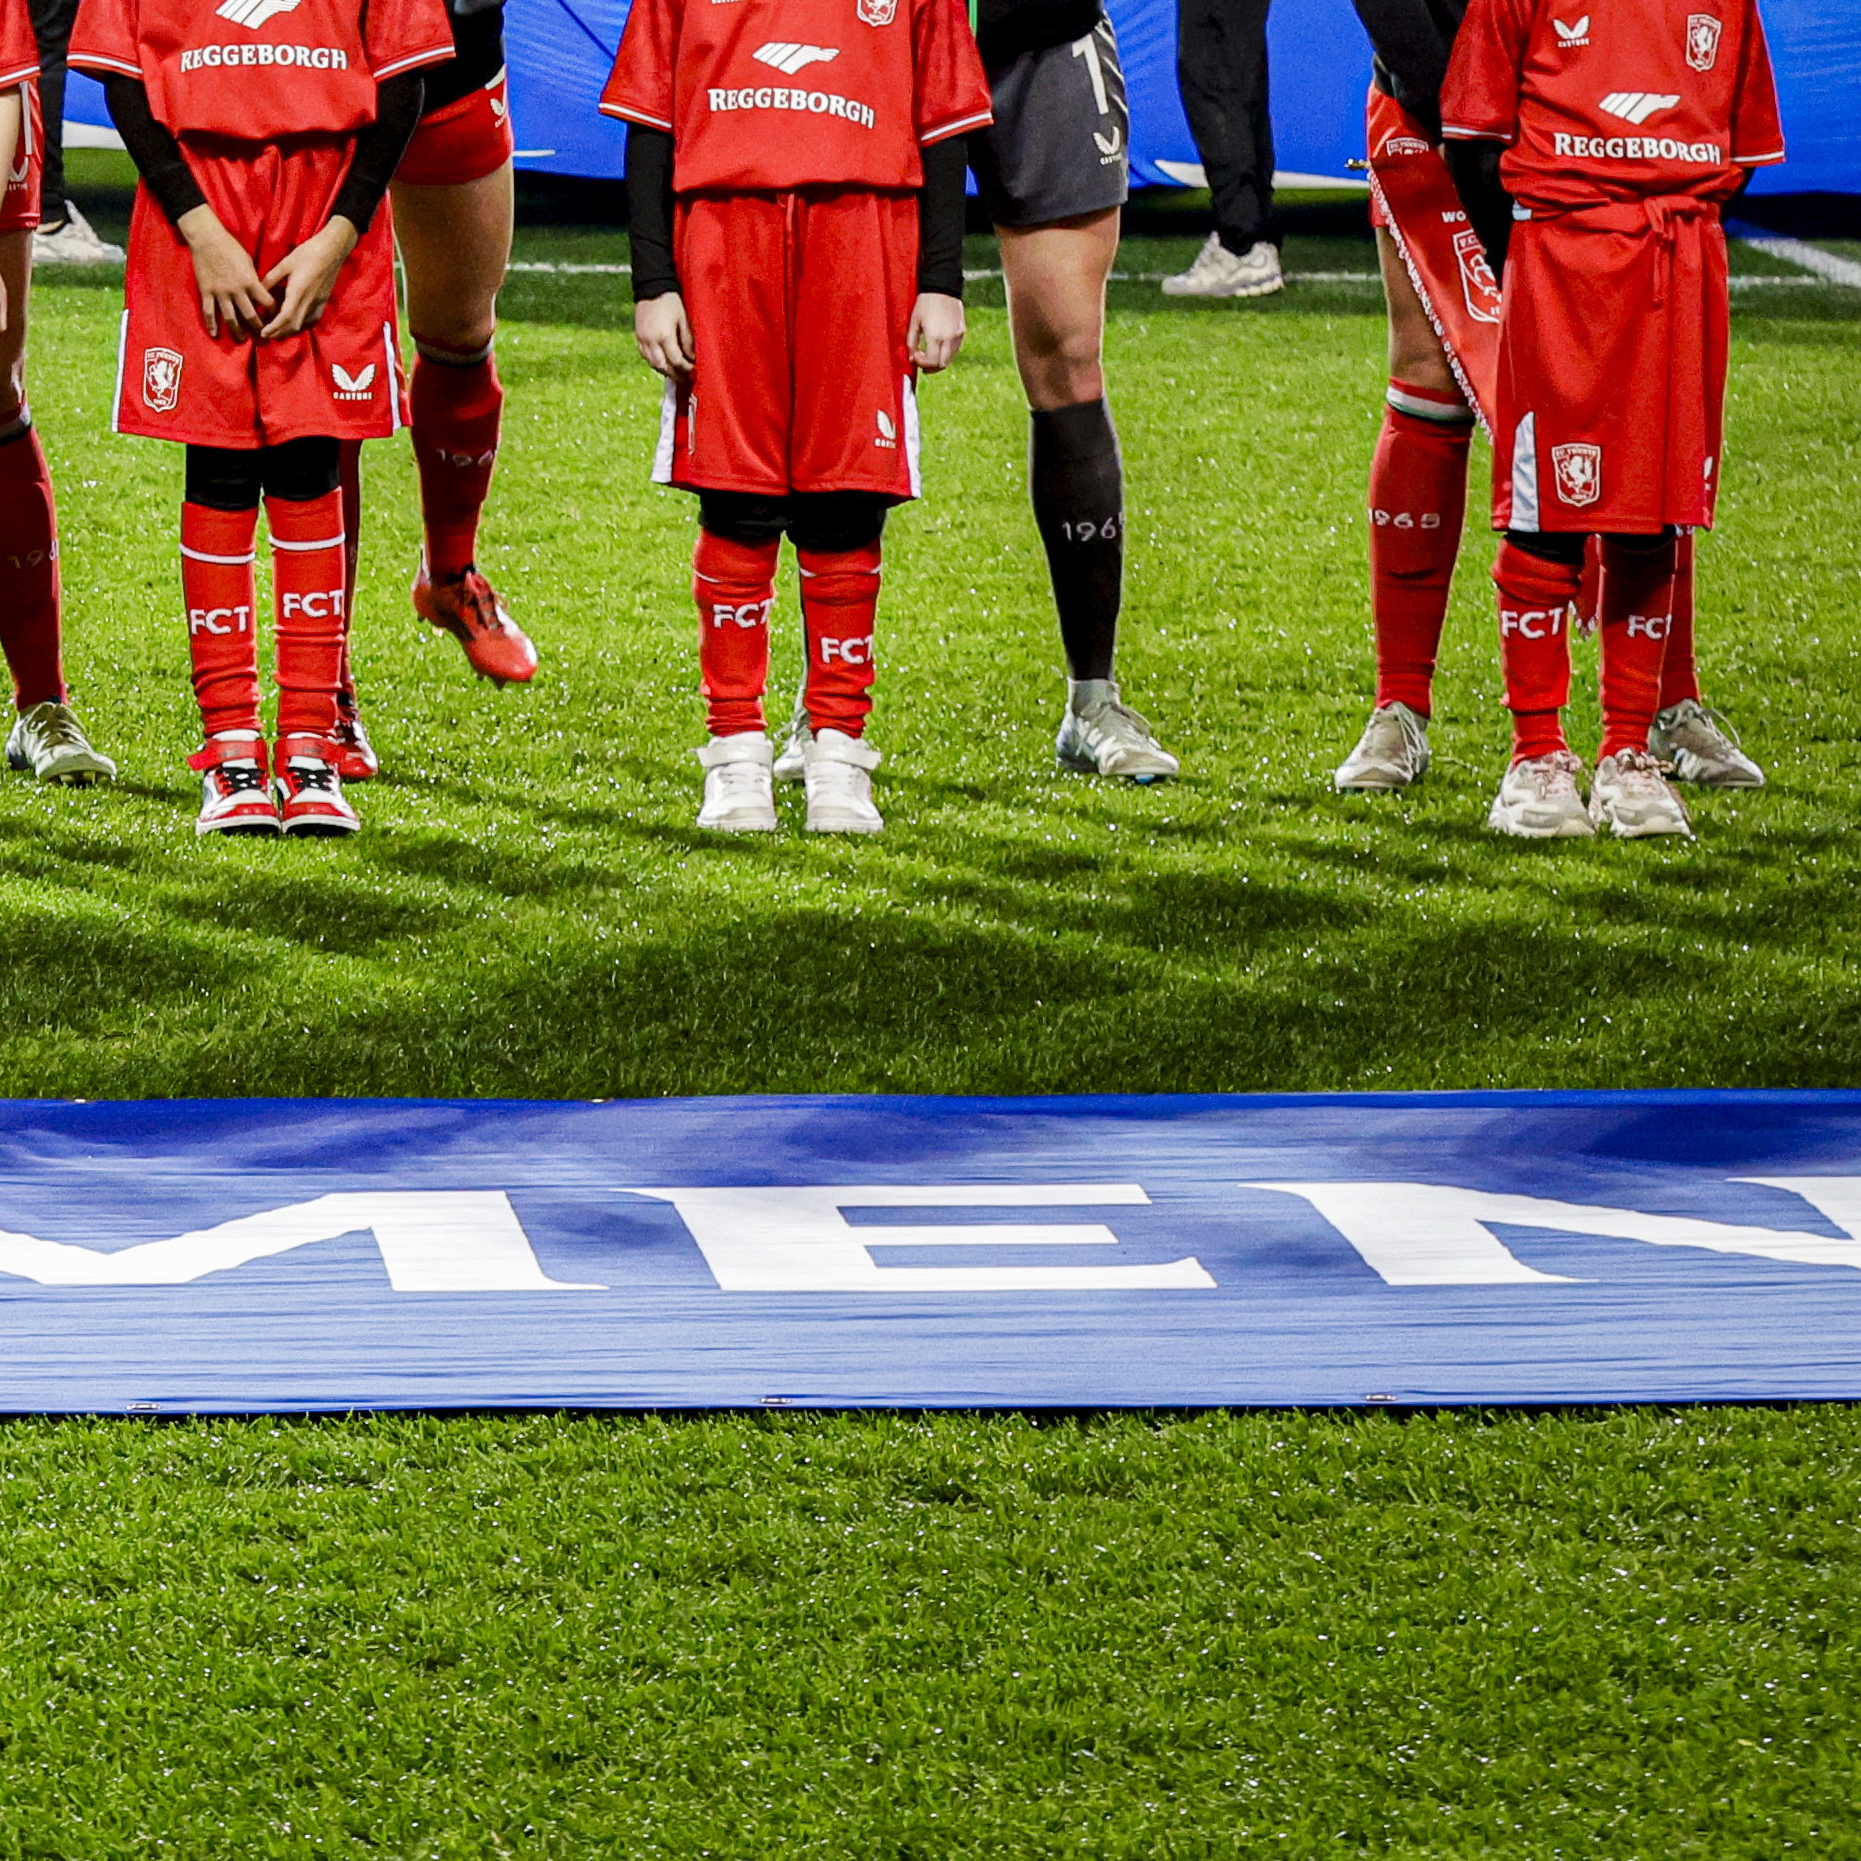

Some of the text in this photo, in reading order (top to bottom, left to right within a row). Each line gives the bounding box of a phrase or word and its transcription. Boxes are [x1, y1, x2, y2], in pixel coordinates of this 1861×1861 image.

[180, 44, 348, 73] REGGEBORGH
[707, 87, 874, 129] REGGEBORGH
[1553, 132, 1722, 166] REGGEBORGH
[283, 590, 343, 619] FCT
[713, 598, 773, 628] FCT
[189, 605, 249, 635] FCT
[1502, 607, 1564, 639] FCT
